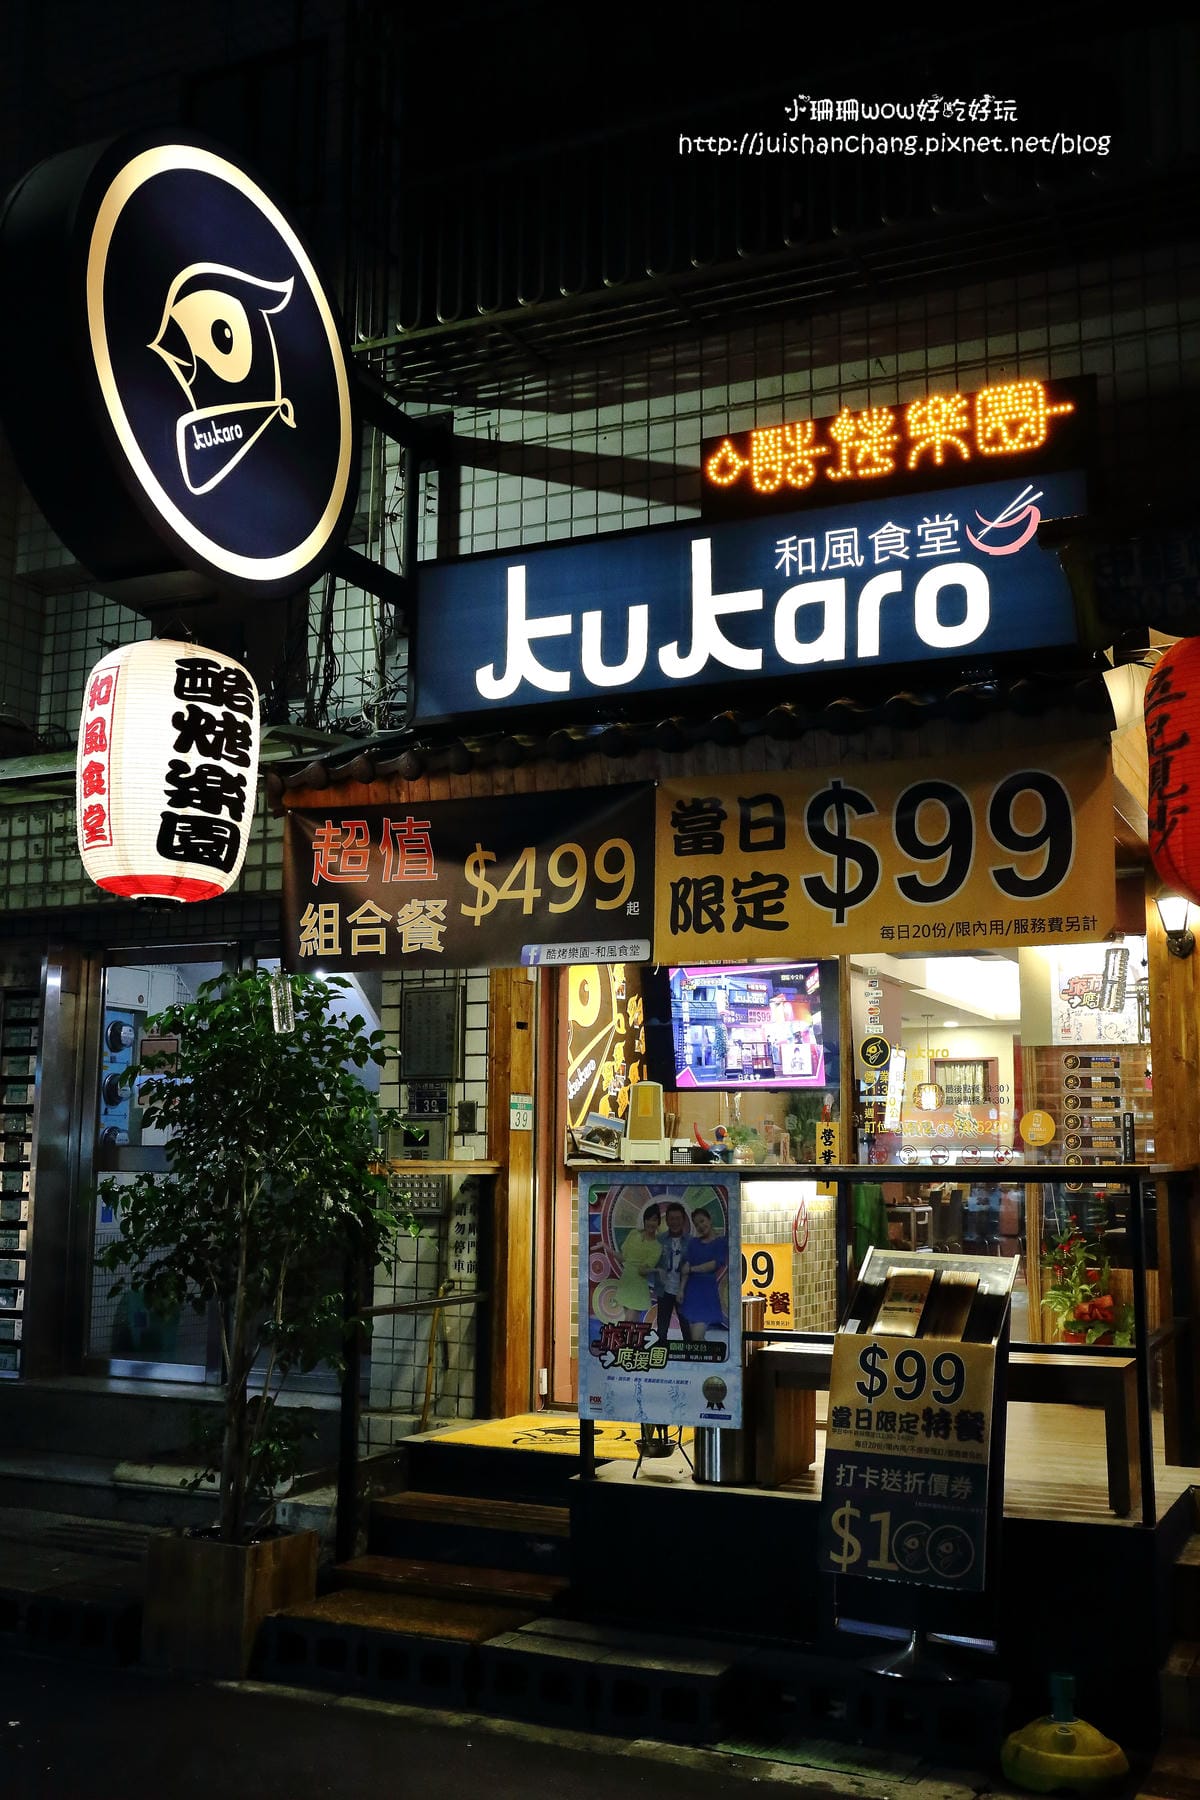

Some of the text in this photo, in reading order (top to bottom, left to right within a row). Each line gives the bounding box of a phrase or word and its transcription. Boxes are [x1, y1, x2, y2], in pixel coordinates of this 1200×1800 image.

[193, 423, 243, 450] kukaro
[774, 513, 963, 578] 和風食堂
[475, 536, 991, 700] kukaro
[311, 816, 439, 887] 超值
[669, 792, 788, 858] 當日
[800, 768, 1077, 928] $99
[460, 838, 636, 927] $499
[626, 901, 640, 917] 起
[669, 870, 790, 936] 限定
[298, 898, 448, 958] 組合餐
[879, 914, 1098, 942] 每日20份/限內用/服務費另計
[423, 1099, 438, 1112] 39
[514, 1111, 528, 1128] 39
[855, 1342, 966, 1405] $99
[835, 1463, 973, 1500] 打卡送折價券
